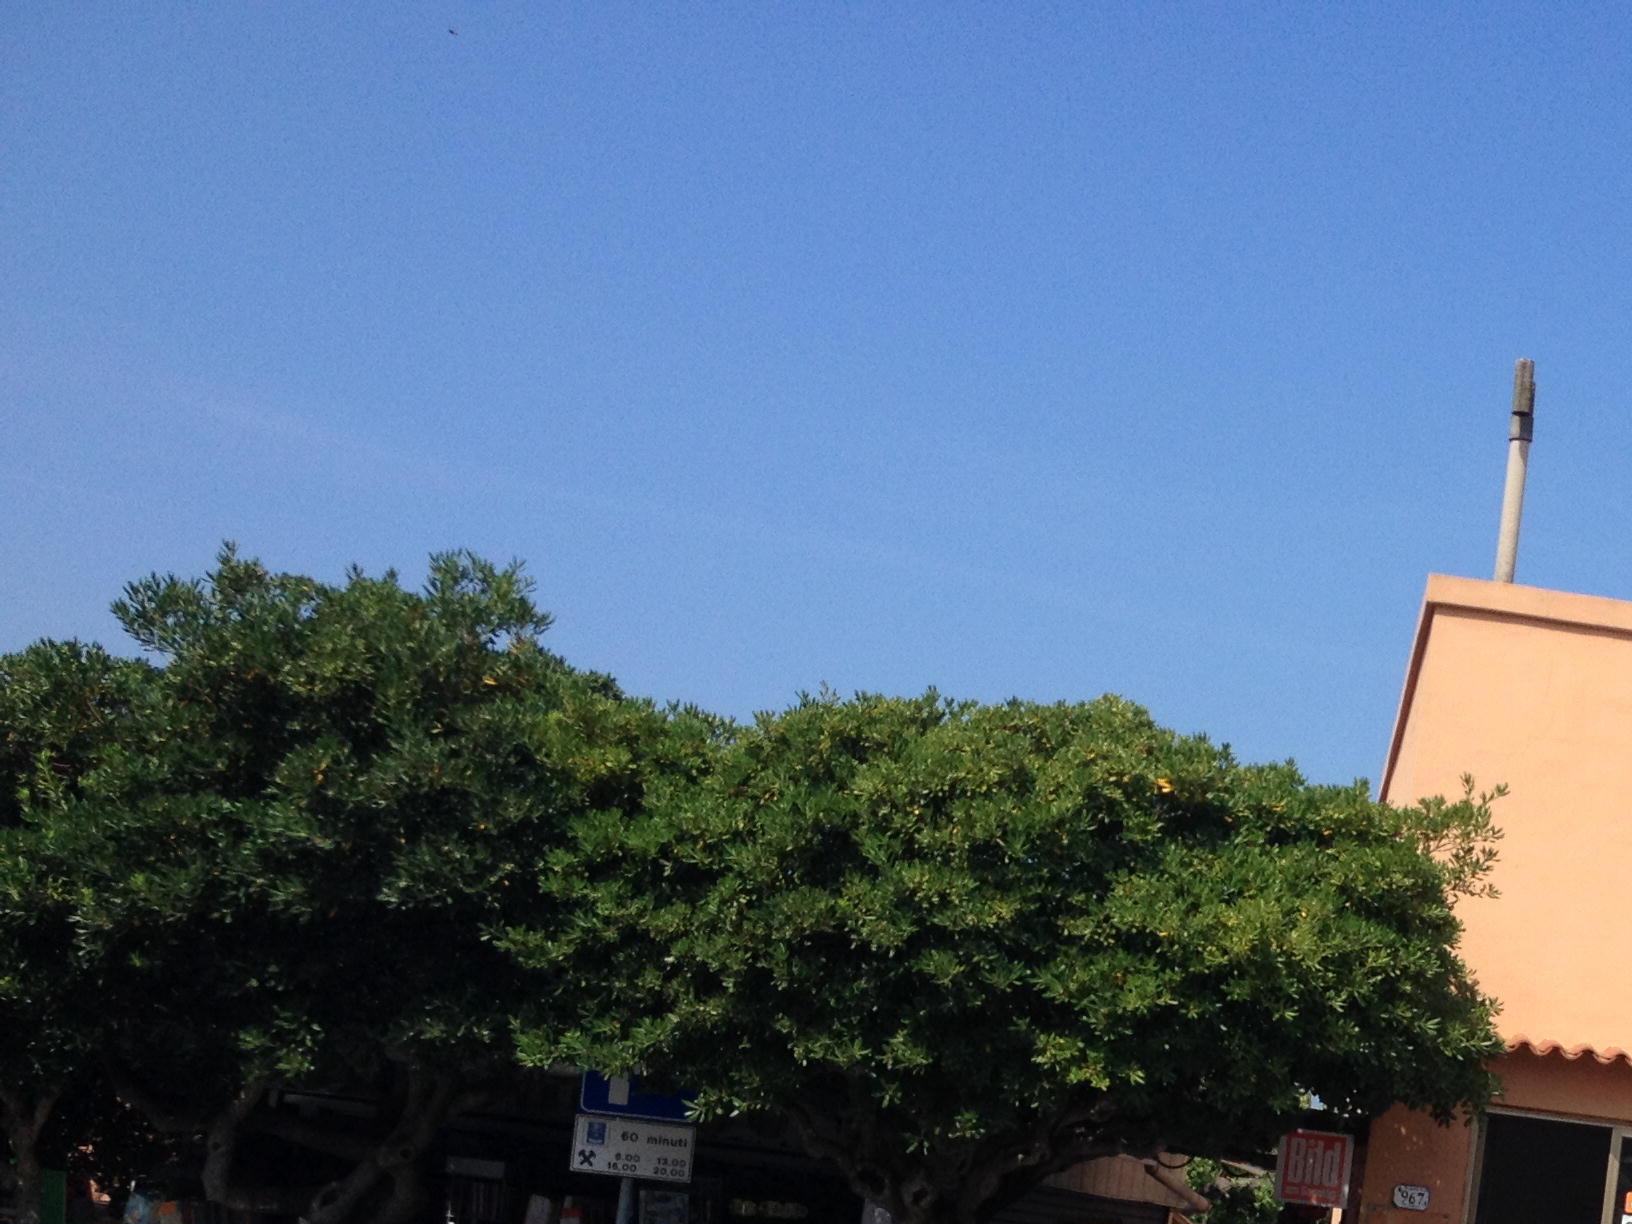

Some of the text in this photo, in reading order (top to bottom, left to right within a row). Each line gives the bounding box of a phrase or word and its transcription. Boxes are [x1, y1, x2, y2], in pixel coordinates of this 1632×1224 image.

[621, 1130, 688, 1148] 60 minuti
[1287, 1136, 1342, 1187] Bild
